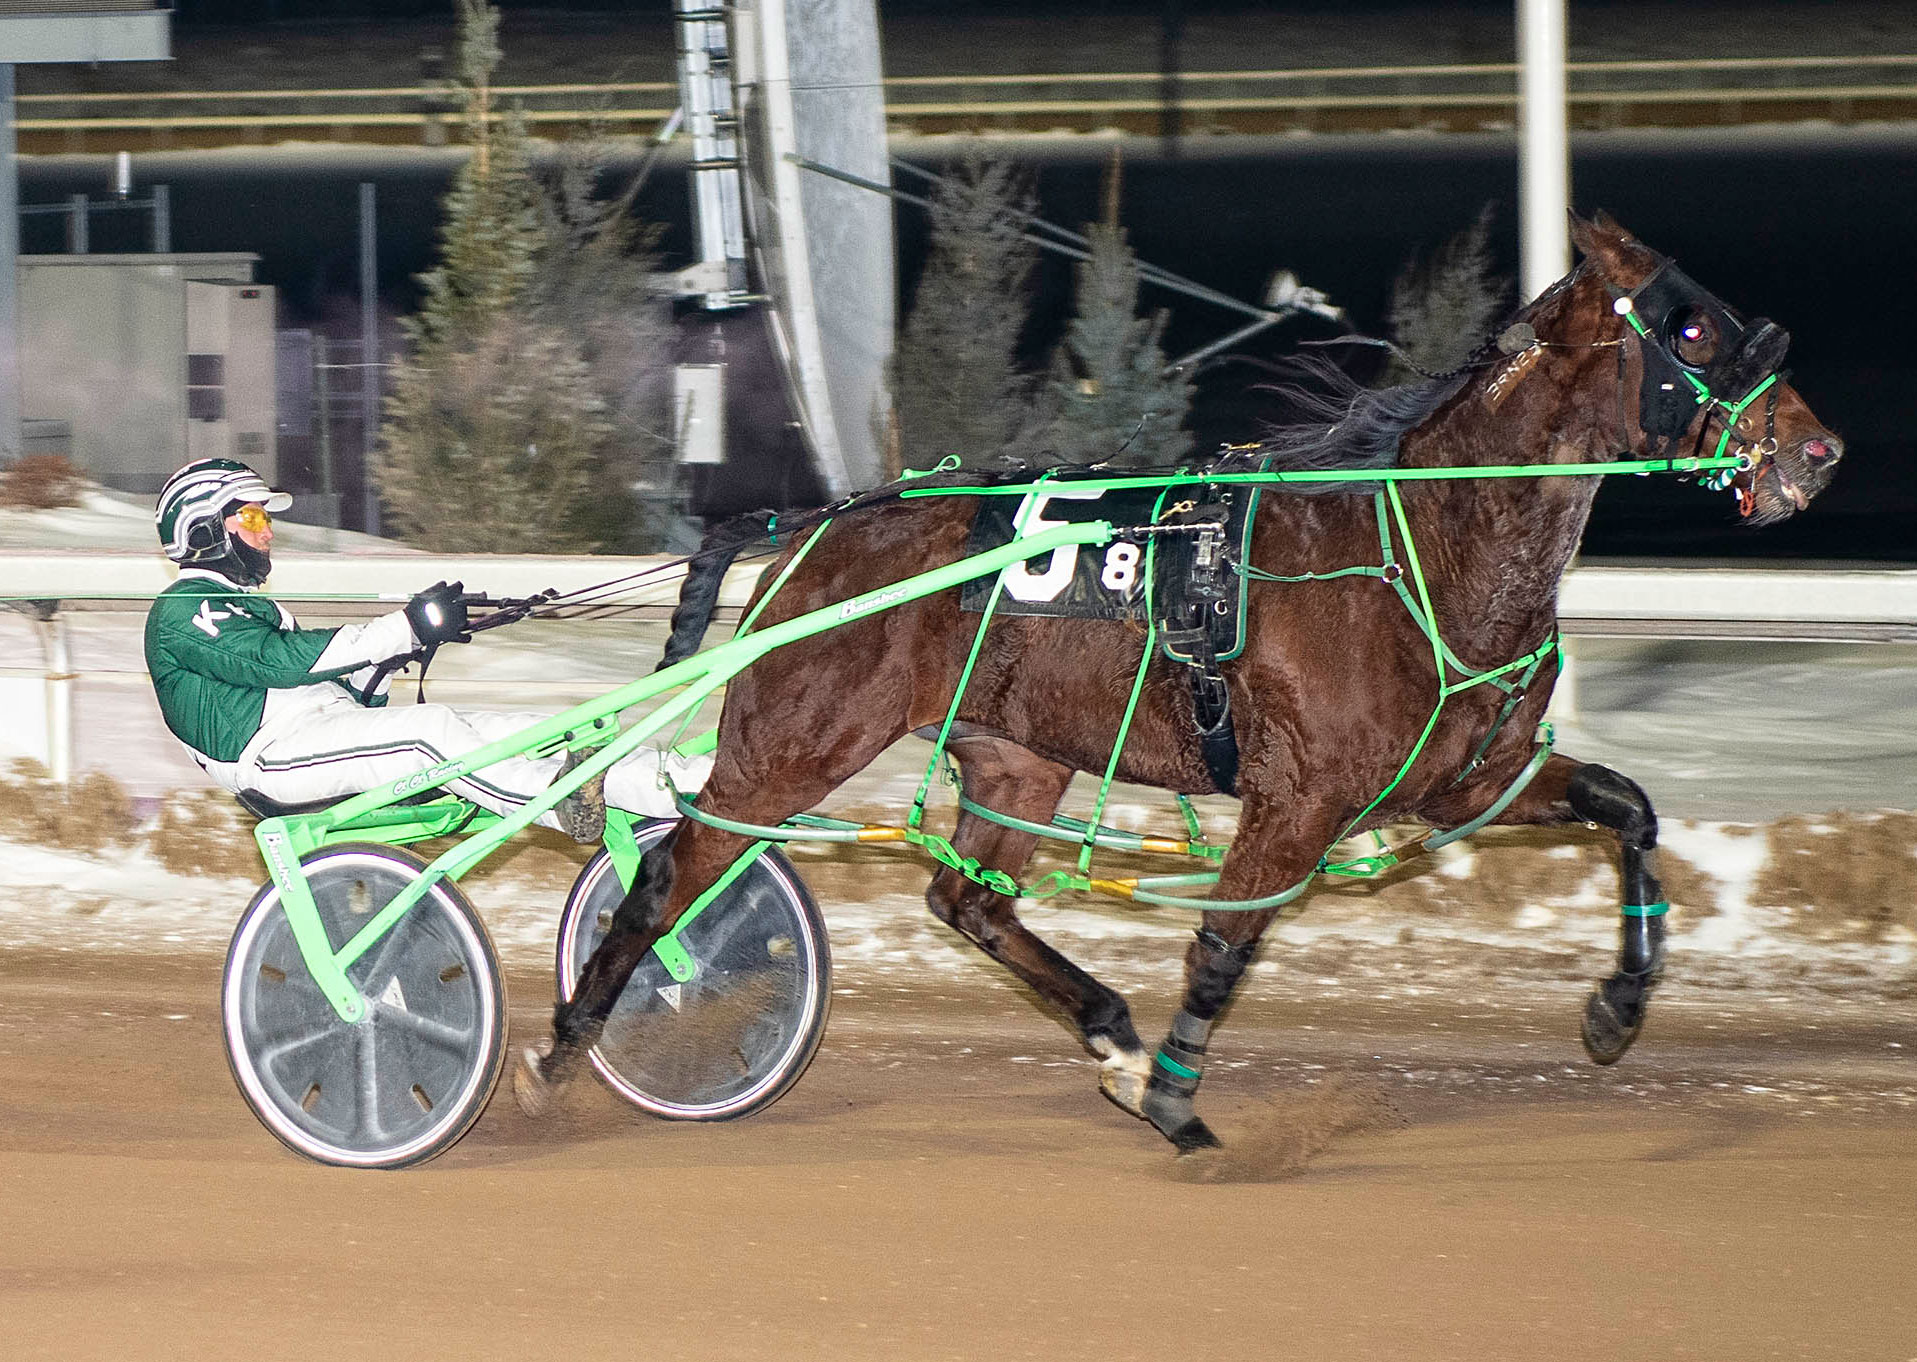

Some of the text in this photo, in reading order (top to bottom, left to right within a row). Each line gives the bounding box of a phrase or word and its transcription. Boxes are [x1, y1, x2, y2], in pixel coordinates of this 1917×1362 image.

[1003, 479, 1107, 602] 5
[1101, 542, 1141, 590] 8
[839, 587, 907, 620] Banshee
[262, 831, 295, 892] Banshee
